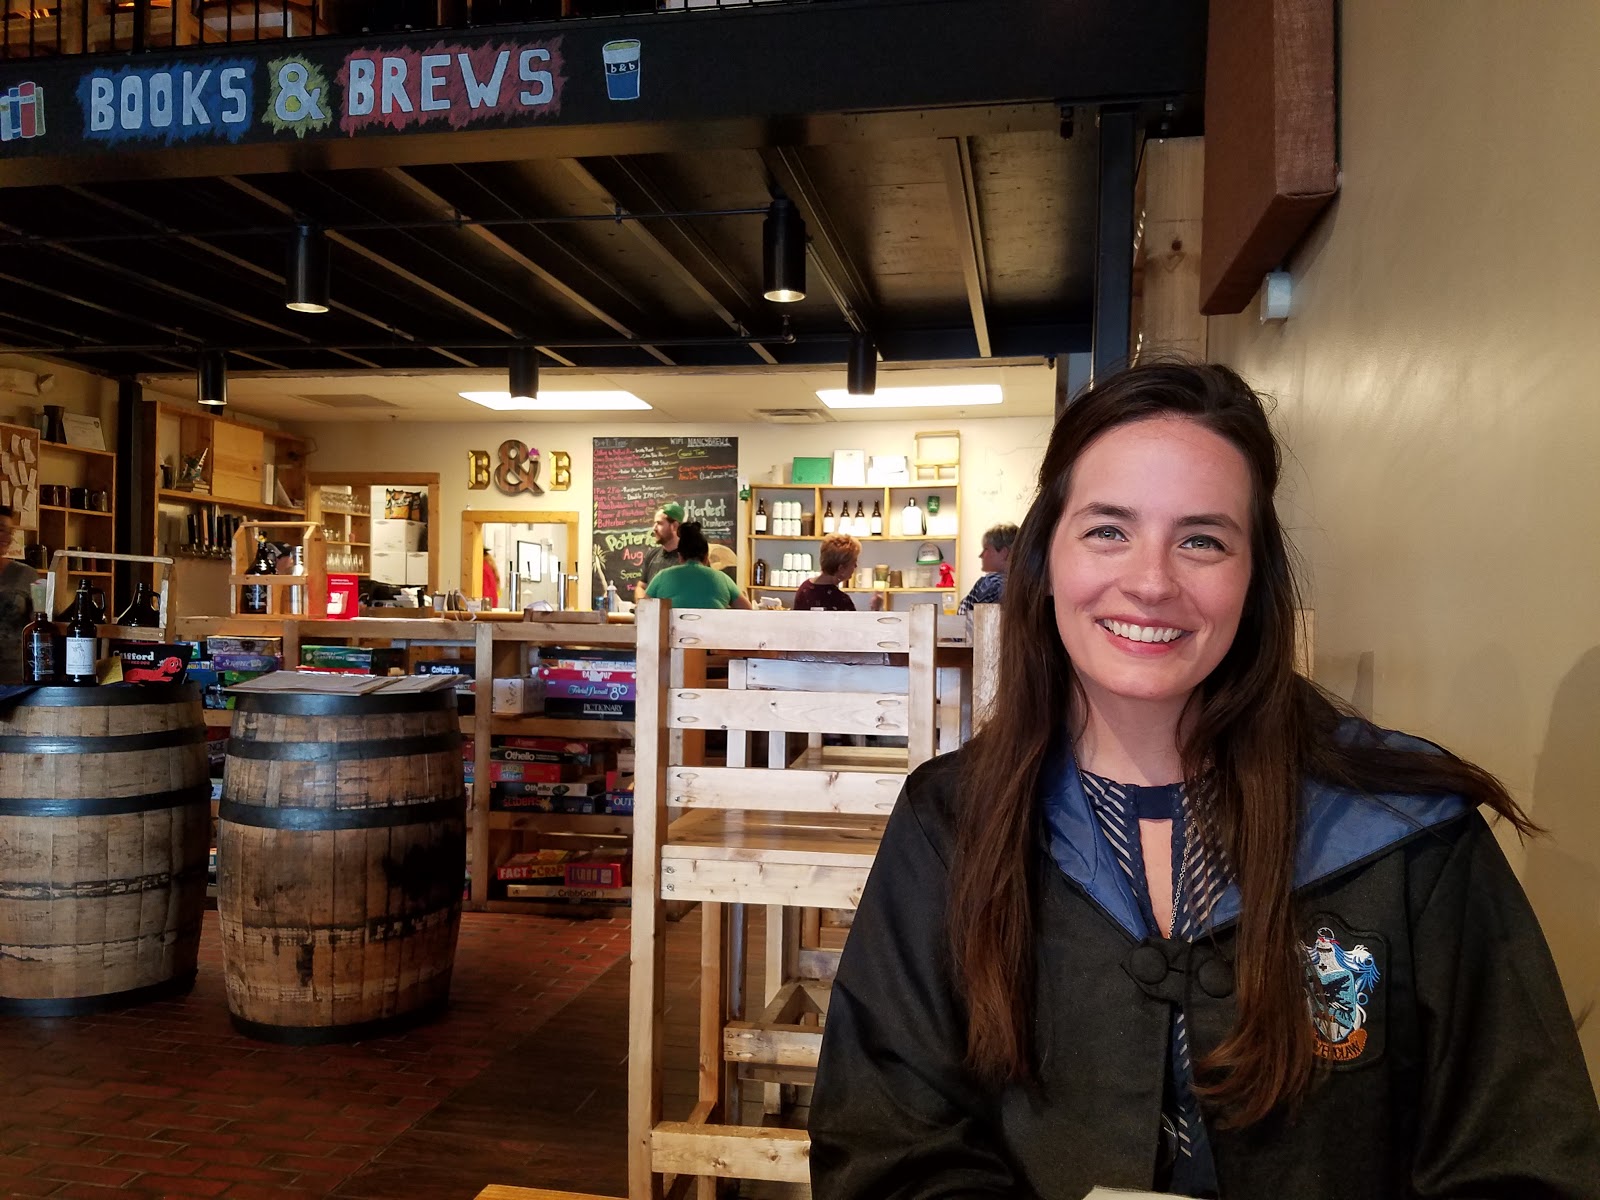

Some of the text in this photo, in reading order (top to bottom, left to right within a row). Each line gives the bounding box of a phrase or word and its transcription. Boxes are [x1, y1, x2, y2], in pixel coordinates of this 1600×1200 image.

[91, 48, 554, 131] BOOKS & BREWS
[605, 530, 662, 552] Potterfe
[623, 548, 644, 566] Aug
[583, 703, 623, 712] PICTIONARY
[504, 750, 535, 761] Othello
[524, 784, 551, 792] Othello
[613, 797, 634, 806] OUT
[500, 867, 528, 879] FACT
